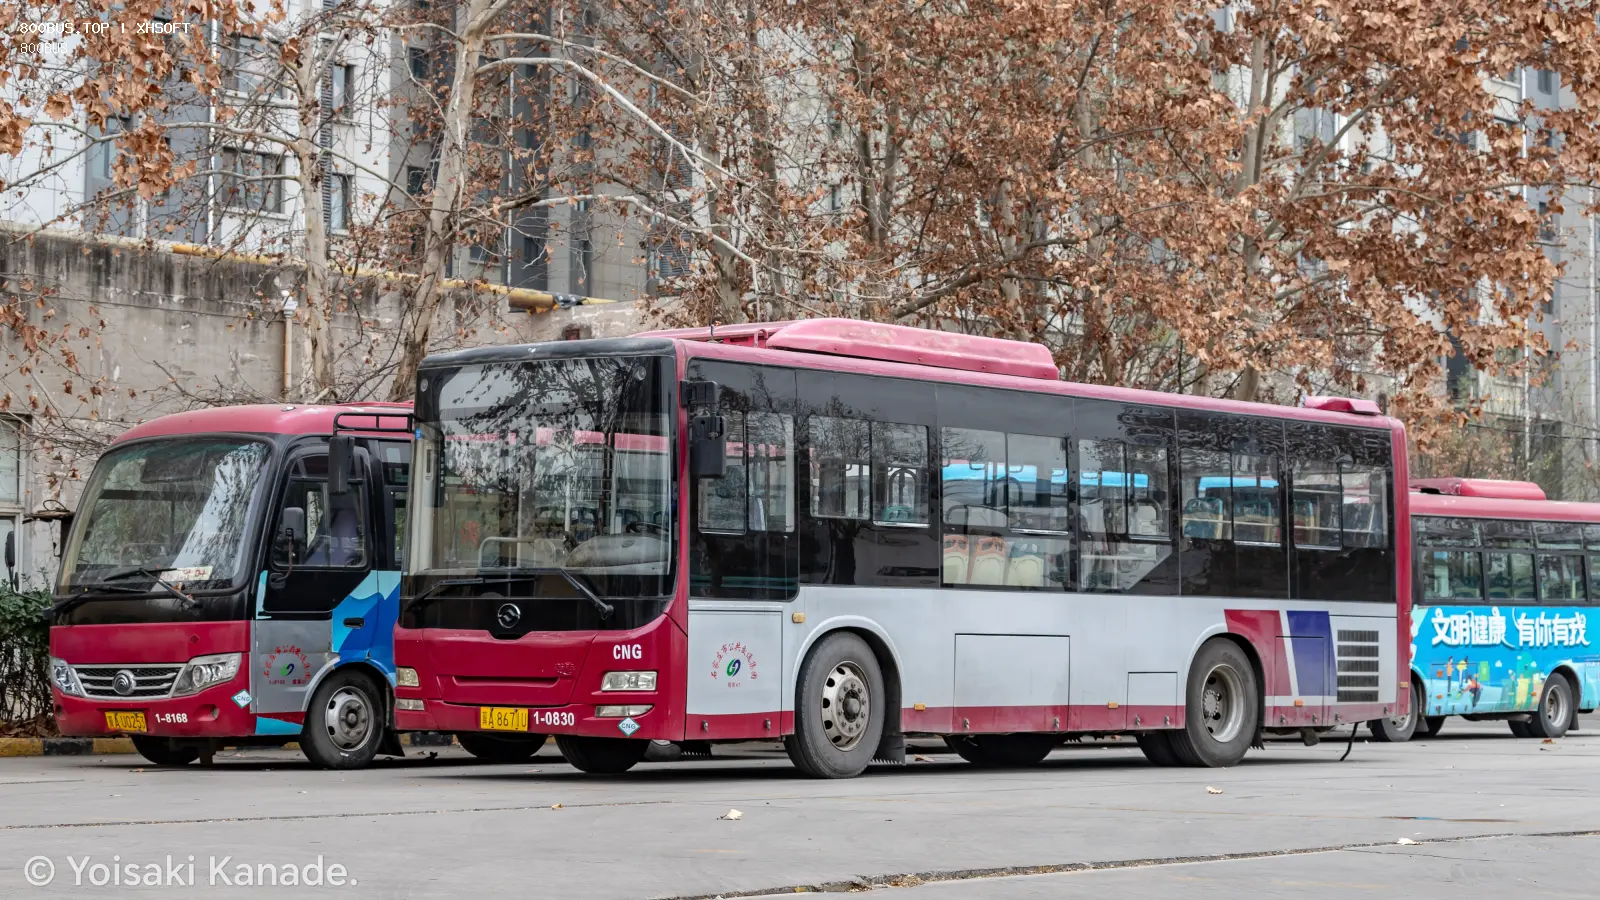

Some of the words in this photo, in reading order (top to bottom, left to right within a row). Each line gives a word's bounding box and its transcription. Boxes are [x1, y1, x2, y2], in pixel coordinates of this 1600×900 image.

[1431, 606, 1515, 648] 文明健康
[1512, 607, 1591, 647] 有你有我
[613, 644, 642, 659] CNG
[155, 712, 188, 724] 1-8168
[533, 711, 575, 726] 1-0830
